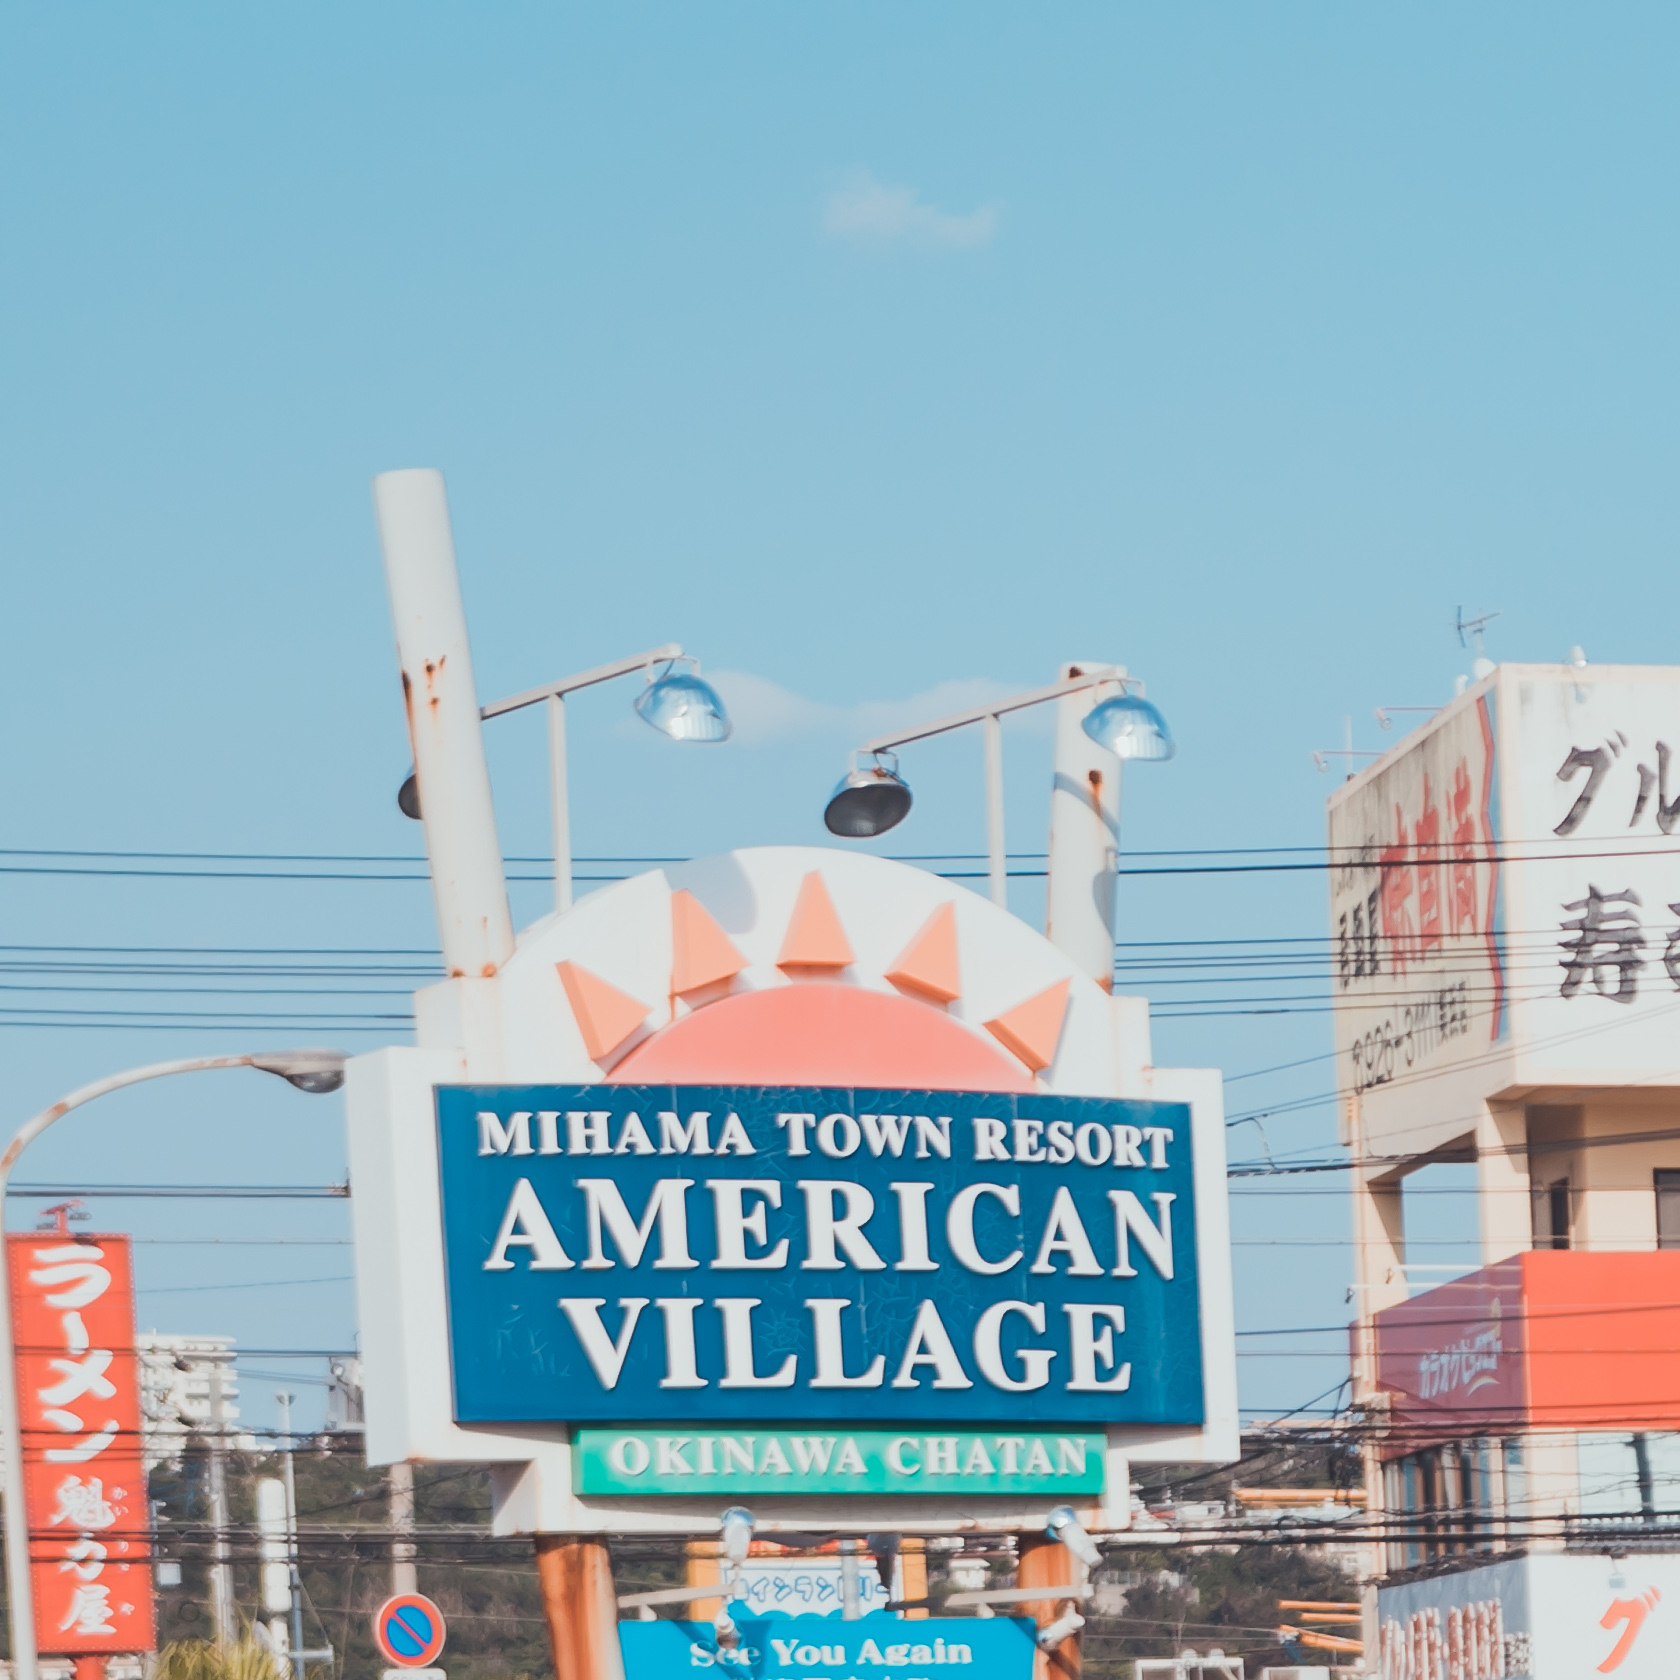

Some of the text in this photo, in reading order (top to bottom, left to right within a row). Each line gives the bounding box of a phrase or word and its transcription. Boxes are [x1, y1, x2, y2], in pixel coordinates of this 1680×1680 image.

[477, 1111, 1175, 1170] MIHAMA TOWN RESORT
[482, 1176, 1178, 1281] AMERICAN
[29, 1243, 118, 1464] ラーメン
[559, 1297, 1134, 1392] VILLAGE
[611, 1436, 1087, 1476] OKINAWA CHATAN
[690, 1636, 973, 1669] See You Again
